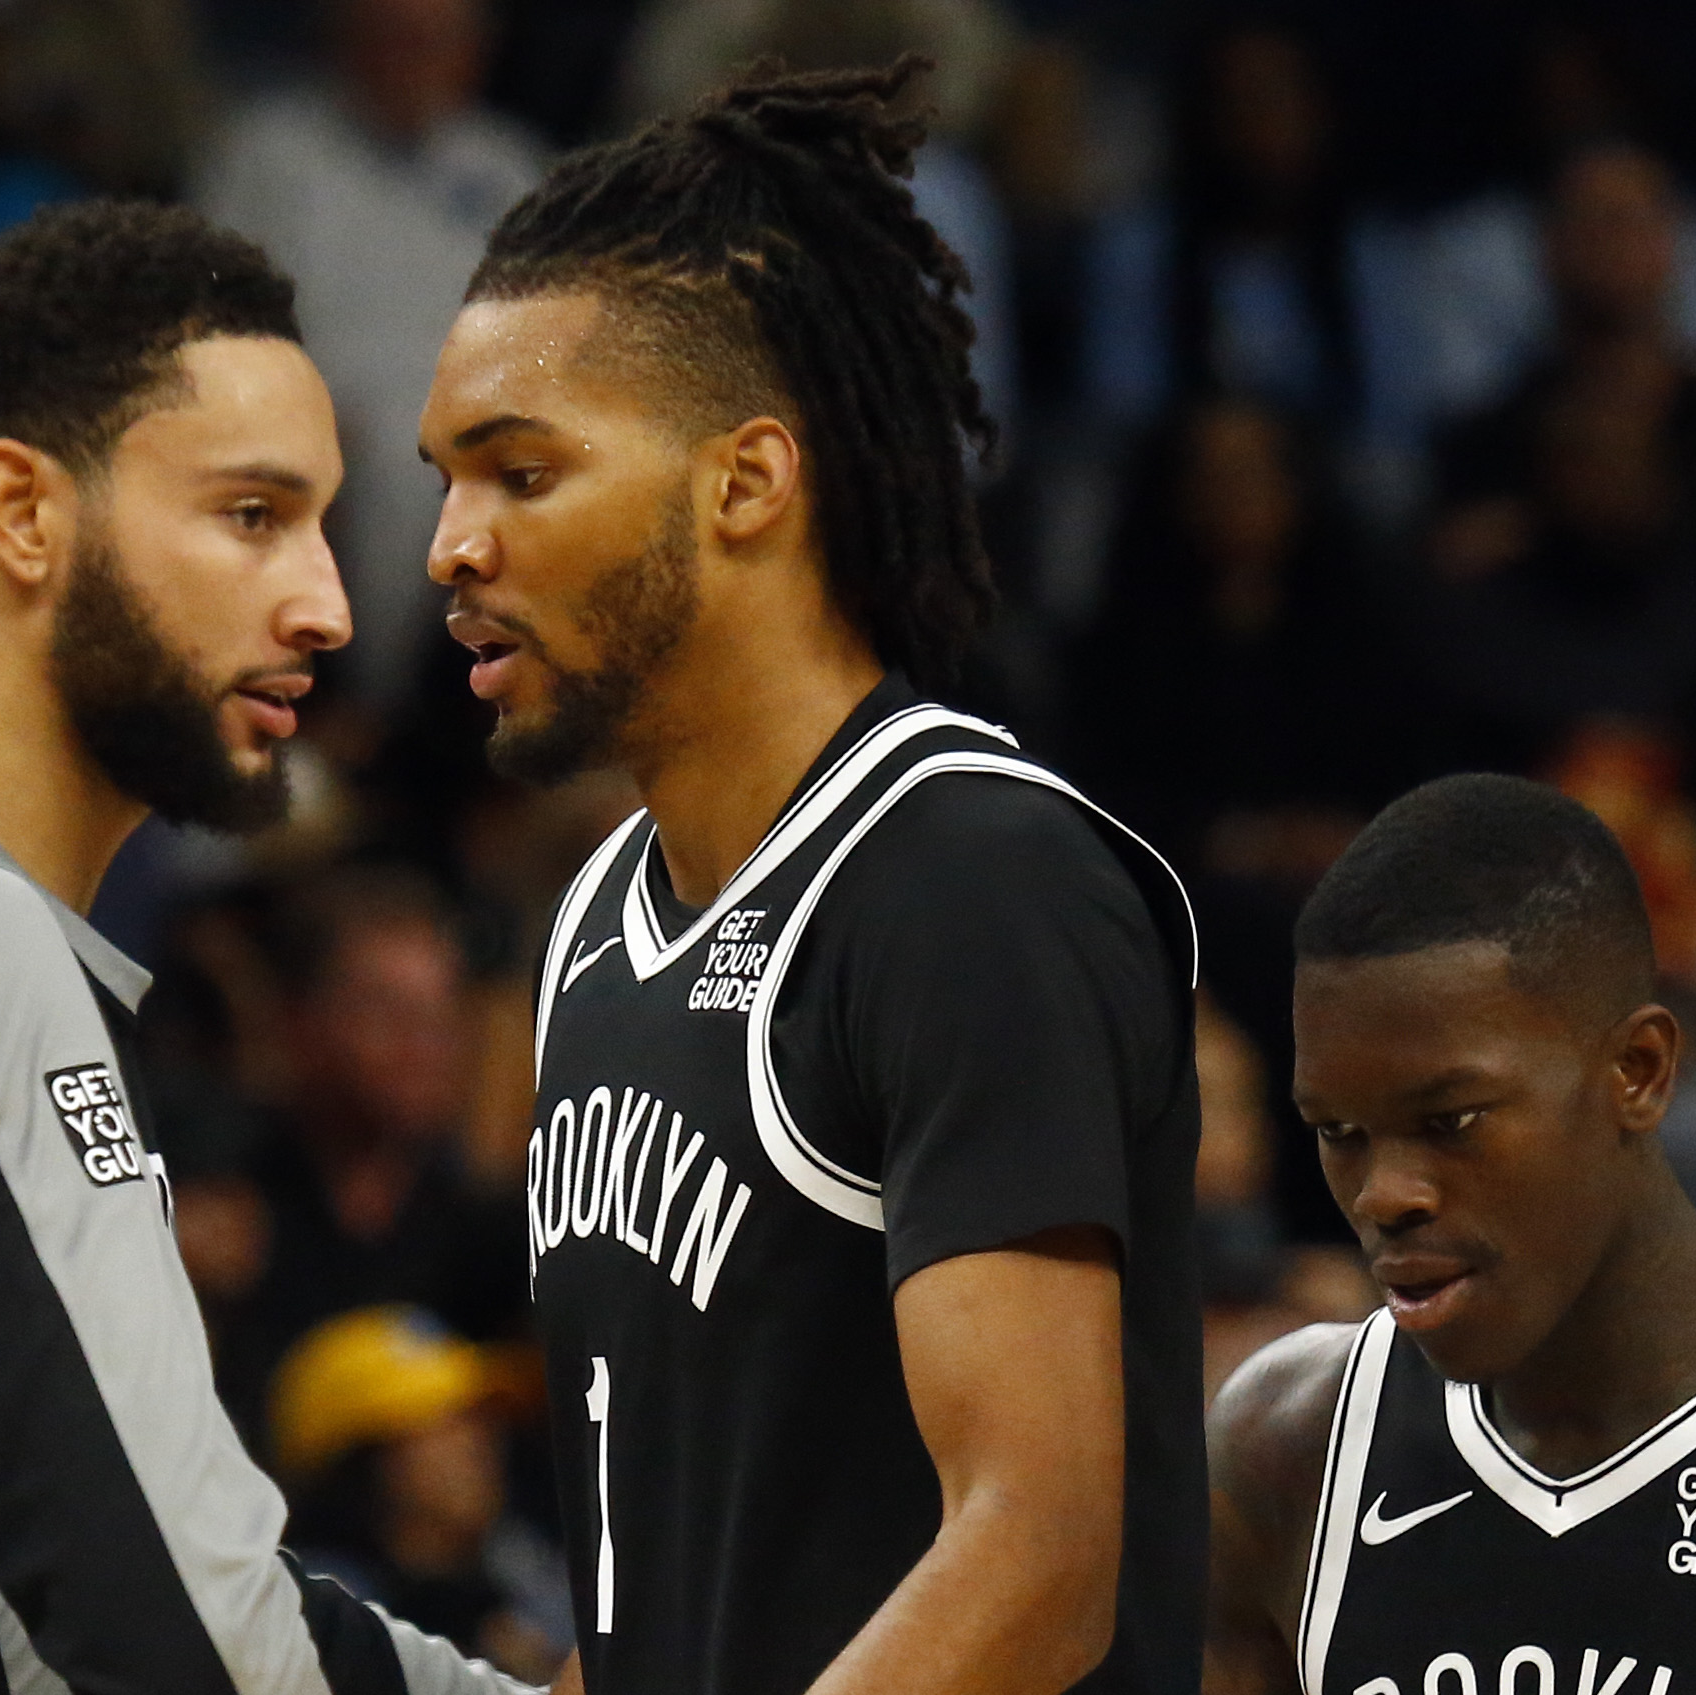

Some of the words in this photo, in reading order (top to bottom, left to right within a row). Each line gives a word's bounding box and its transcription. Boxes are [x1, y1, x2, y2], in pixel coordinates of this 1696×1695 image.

[717, 910, 766, 940] GET
[704, 943, 768, 976] YOUR
[688, 977, 761, 1012] GUIDE
[51, 1069, 119, 1111] GET
[527, 1086, 752, 1312] ROOKLYN
[585, 1357, 614, 1634] 1
